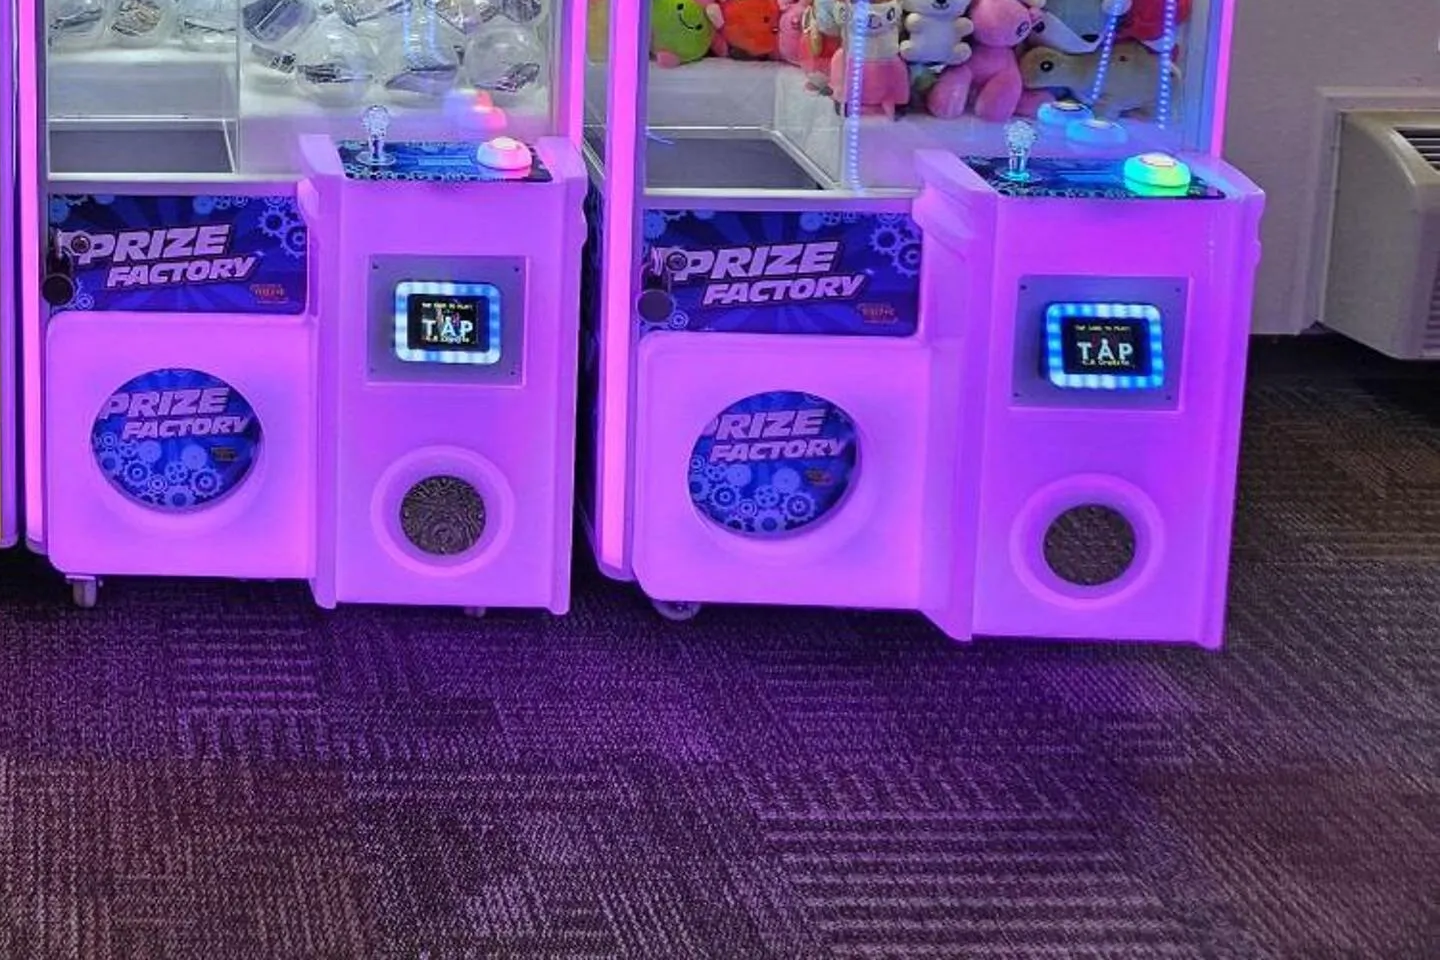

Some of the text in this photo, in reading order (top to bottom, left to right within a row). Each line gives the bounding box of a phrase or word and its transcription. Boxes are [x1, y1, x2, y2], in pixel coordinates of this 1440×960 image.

[74, 224, 231, 265] PRIZE
[107, 256, 257, 288] FACTORY
[670, 242, 839, 281] PRIZE
[702, 274, 865, 306] FACTORY
[421, 317, 473, 339] TAP
[1076, 339, 1134, 362] TAP
[99, 387, 229, 420] PRIZE
[122, 415, 252, 441] FACTORY
[710, 437, 847, 462] FACTORY
